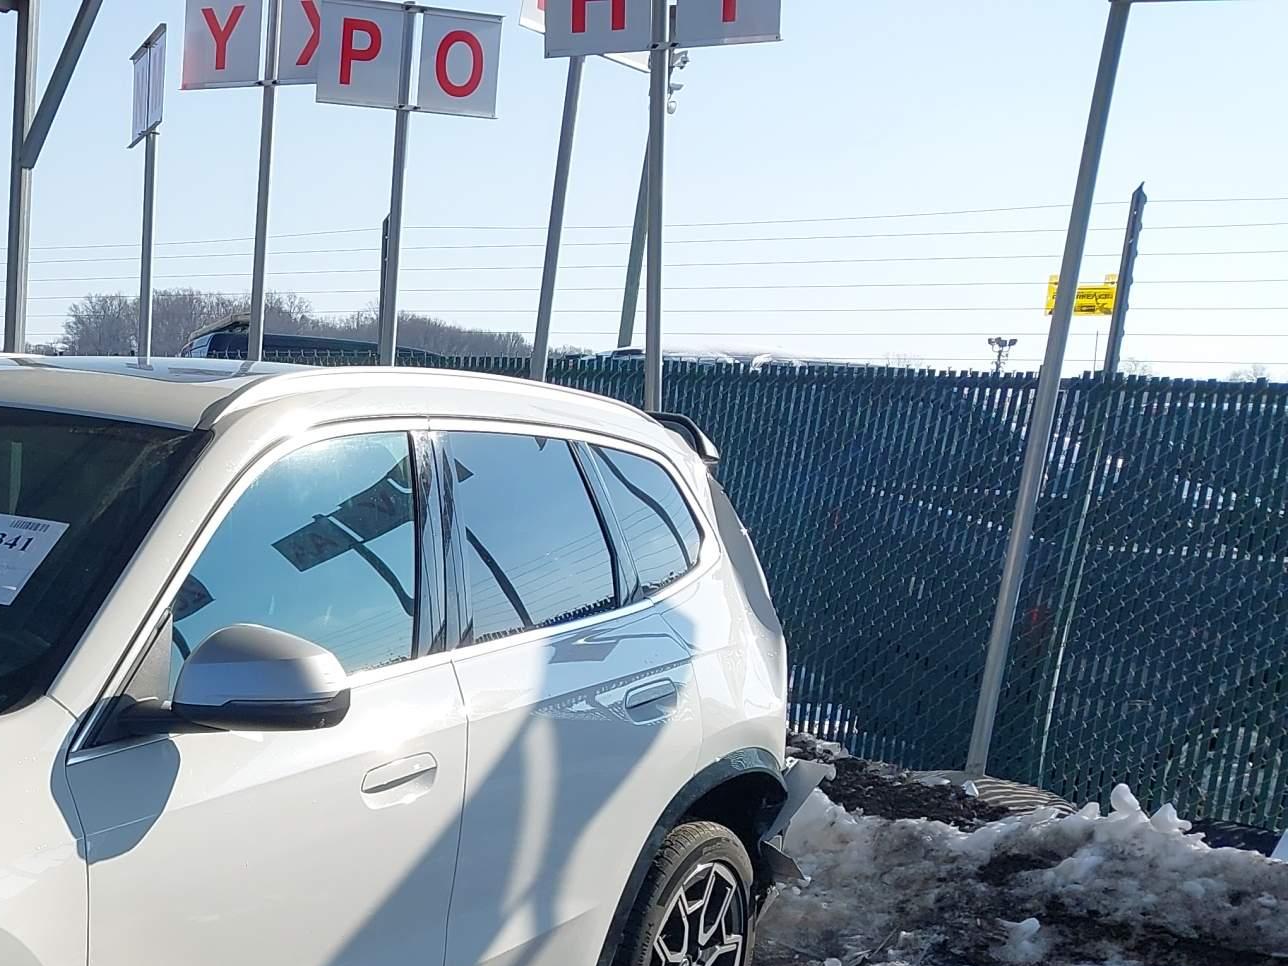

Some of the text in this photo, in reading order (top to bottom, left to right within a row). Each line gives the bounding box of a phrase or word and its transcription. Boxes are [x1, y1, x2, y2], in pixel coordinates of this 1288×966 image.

[201, 4, 246, 71] Y
[339, 16, 484, 98] P O
